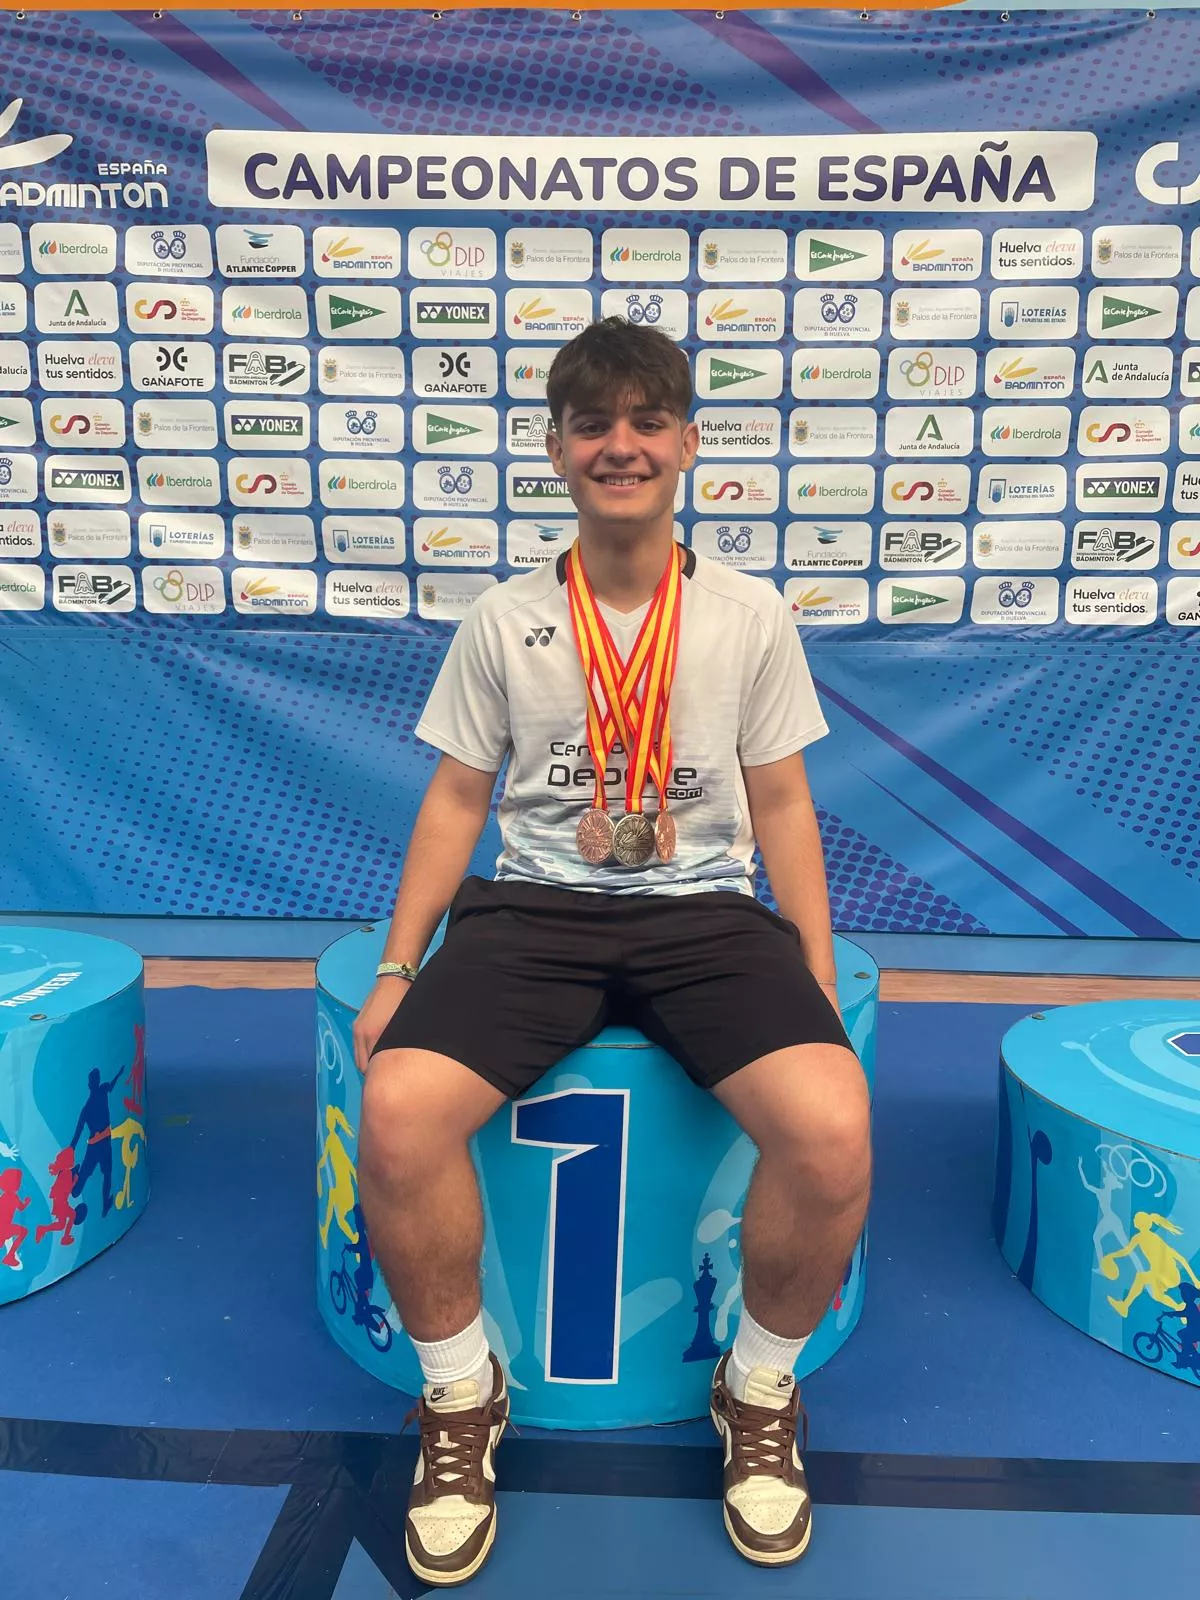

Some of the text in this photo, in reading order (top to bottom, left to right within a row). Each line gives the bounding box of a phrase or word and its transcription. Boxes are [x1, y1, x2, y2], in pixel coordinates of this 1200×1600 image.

[98, 162, 167, 175] ESPAÑA
[244, 141, 1056, 202] CAMPEONATOS DE ESPAÑA
[0, 182, 168, 208] ADMINTON
[59, 243, 108, 254] Iberdrola
[1000, 241, 1076, 253] Huelva eleva
[455, 247, 485, 267] DLP
[631, 250, 681, 261] Iberdrola
[1114, 250, 1132, 258] Palos
[1134, 250, 1142, 258] de
[1144, 250, 1149, 258] la
[333, 260, 392, 269] BADMINTON
[999, 255, 1075, 267] tus sentidos.
[226, 265, 264, 273] ATLANTIC
[913, 263, 973, 271] BADMINTON
[254, 308, 301, 320] Iberdrola
[445, 306, 485, 320] YONEX
[912, 312, 977, 320] Palos de la Frontera
[1022, 307, 1067, 317] LOTERÍAS
[525, 322, 584, 330] BADMINTON
[46, 354, 115, 365] Huelva eleva
[0, 365, 28, 375] alucía
[1113, 363, 1138, 371] Junta
[46, 367, 116, 379] tus sentidos.
[822, 369, 871, 380] Iberdrola
[934, 366, 964, 386] DLP
[1125, 372, 1169, 381] Andalucía
[1005, 382, 1064, 390] BADMINTON
[259, 419, 298, 432] YONEX
[701, 420, 773, 432] Huelva eleva
[1013, 428, 1061, 440] Iberdrola
[512, 439, 546, 447] BÁDMINTO
[701, 435, 773, 445] tus sentidos.
[80, 473, 120, 486] YONEX
[166, 476, 212, 488] Iberdrola
[349, 479, 396, 490] Iberdrola
[819, 486, 867, 497] Iberdrola
[1009, 485, 1055, 494] LOTERÍAS
[1113, 481, 1154, 494] YONEX
[1181, 489, 1198, 499] tus
[7, 523, 34, 533] eleva
[0, 535, 35, 545] ntidos.
[169, 532, 214, 540] LOTERÍAS
[352, 536, 395, 545] LOTERÍAS
[1030, 544, 1059, 552] Frontera
[433, 550, 490, 558] BADMINTON
[187, 583, 214, 599] DLP
[333, 583, 403, 593] Huelva eleva
[1074, 589, 1149, 600] Huelva eleva
[58, 597, 97, 605] BÁDMINTON
[251, 598, 308, 606] BADMINTON
[333, 596, 403, 606] tus sentidos.
[1073, 602, 1148, 613] tus sentidos.
[0, 971, 83, 1007] RONTERA
[511, 1088, 630, 1384] 1
[432, 1387, 446, 1395] NIKE
